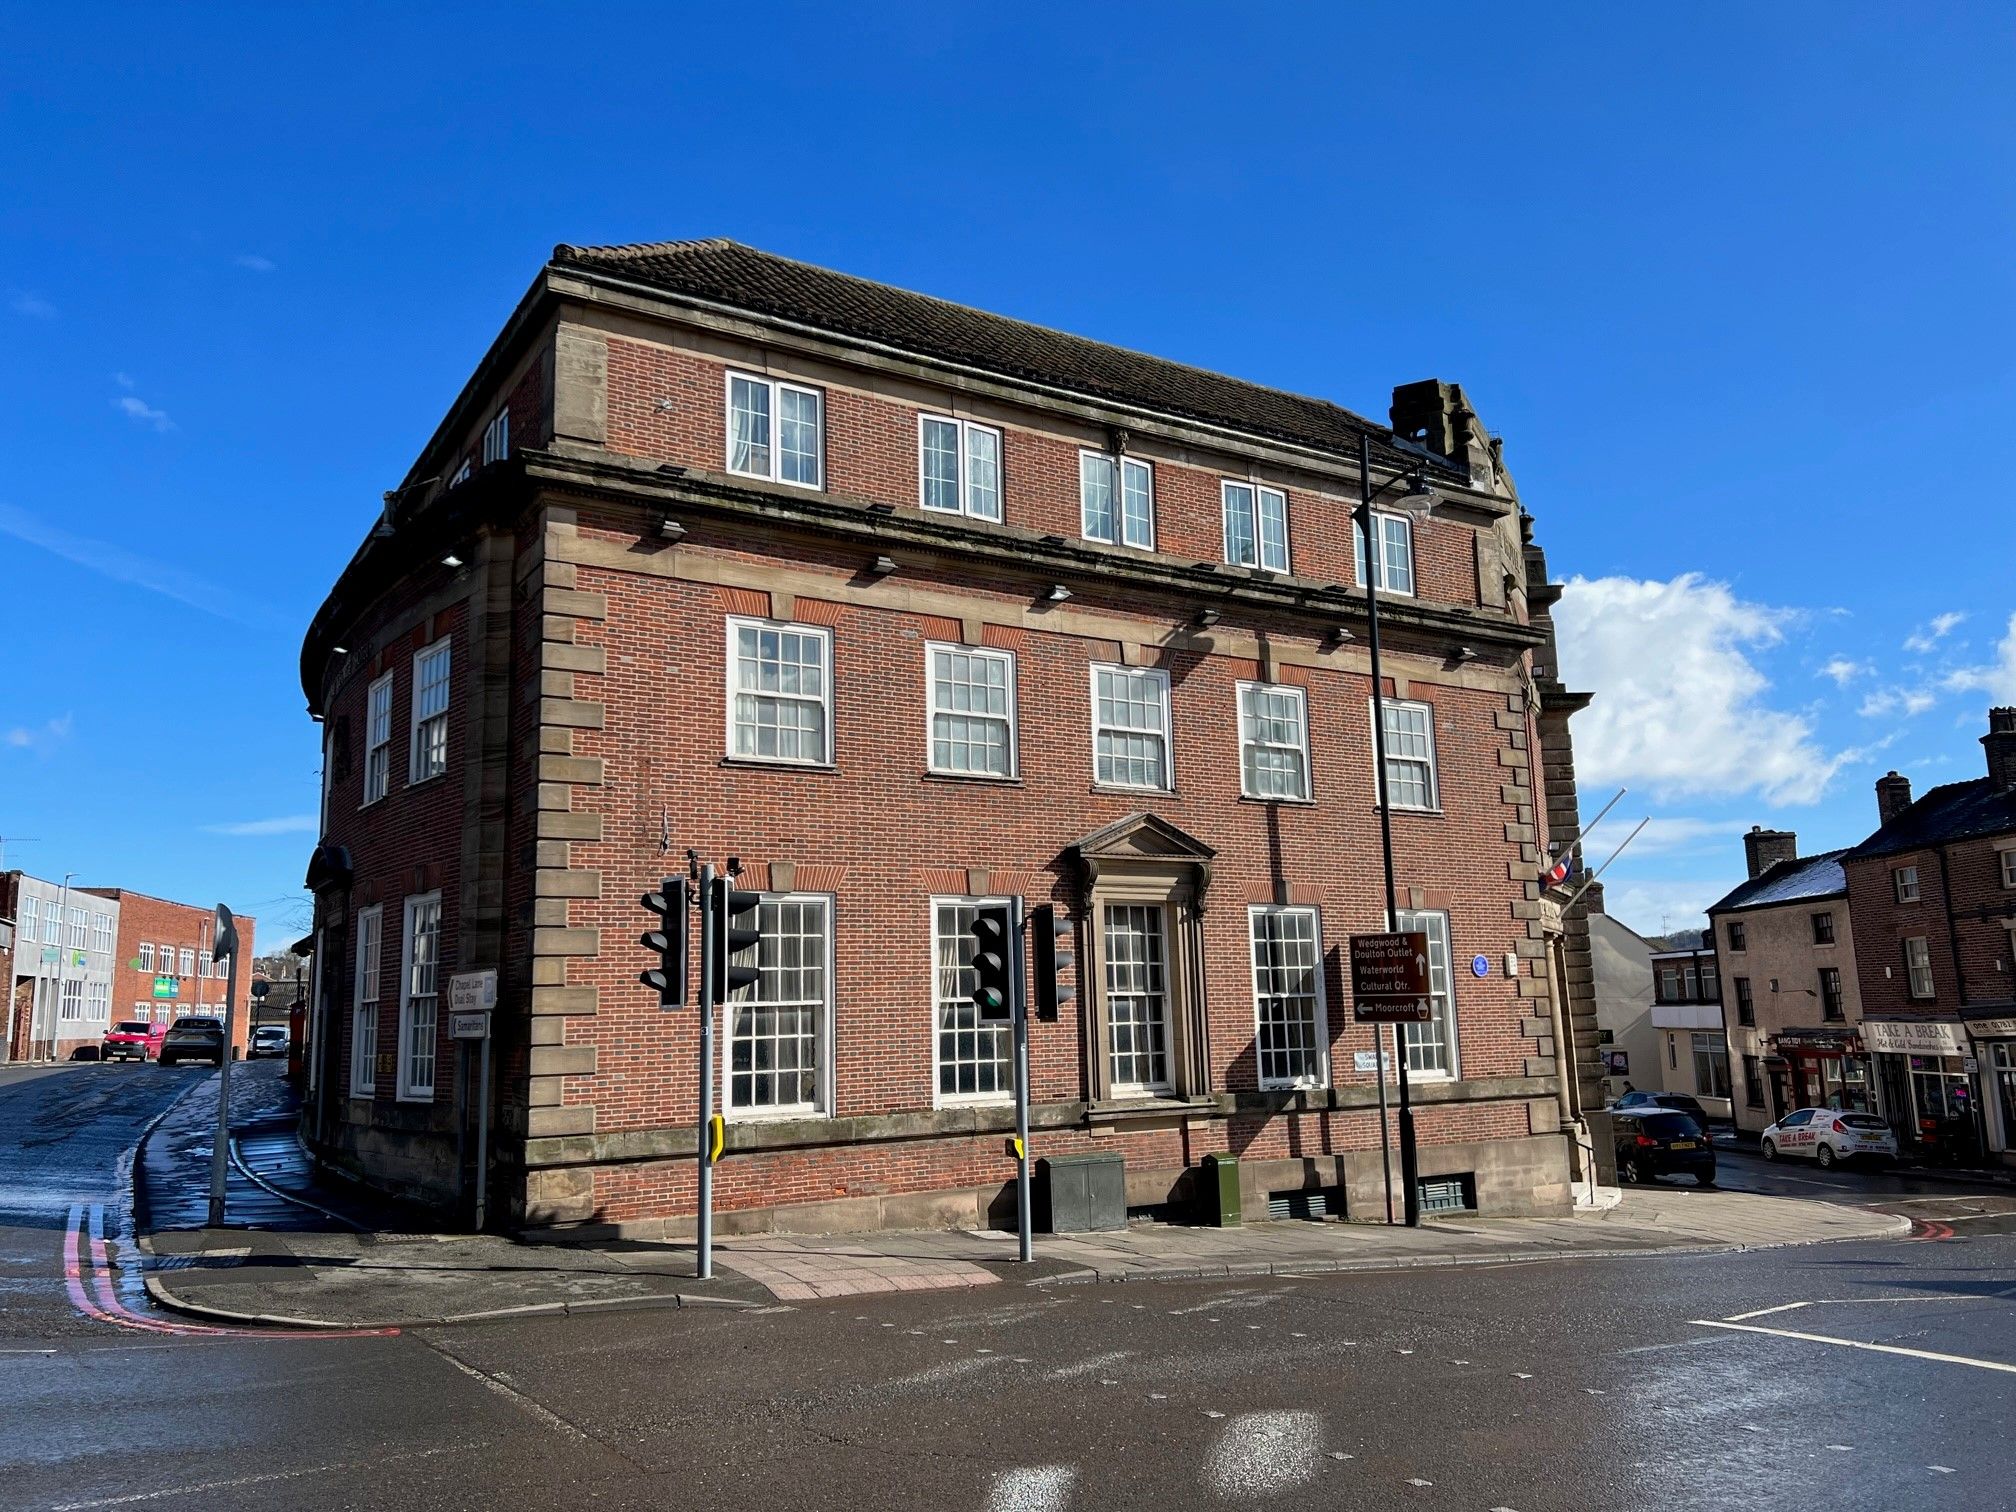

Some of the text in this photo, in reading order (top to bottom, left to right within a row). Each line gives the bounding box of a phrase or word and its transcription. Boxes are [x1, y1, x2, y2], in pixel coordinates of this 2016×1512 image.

[1358, 937, 1408, 949] Wedgwood &
[1354, 948, 1413, 959] Doulton Outlet
[1359, 964, 1404, 974] Waterworld
[472, 978, 483, 989] Lane
[1360, 981, 1411, 991] Cultural Qtr.
[1375, 1003, 1415, 1013] Moorcroft
[701, 1027, 707, 1035] 3
[1874, 1024, 1951, 1039] TAKE A BREAK
[1364, 1053, 1377, 1061] SWA
[1779, 1131, 1816, 1143] TAKE A BREAK
